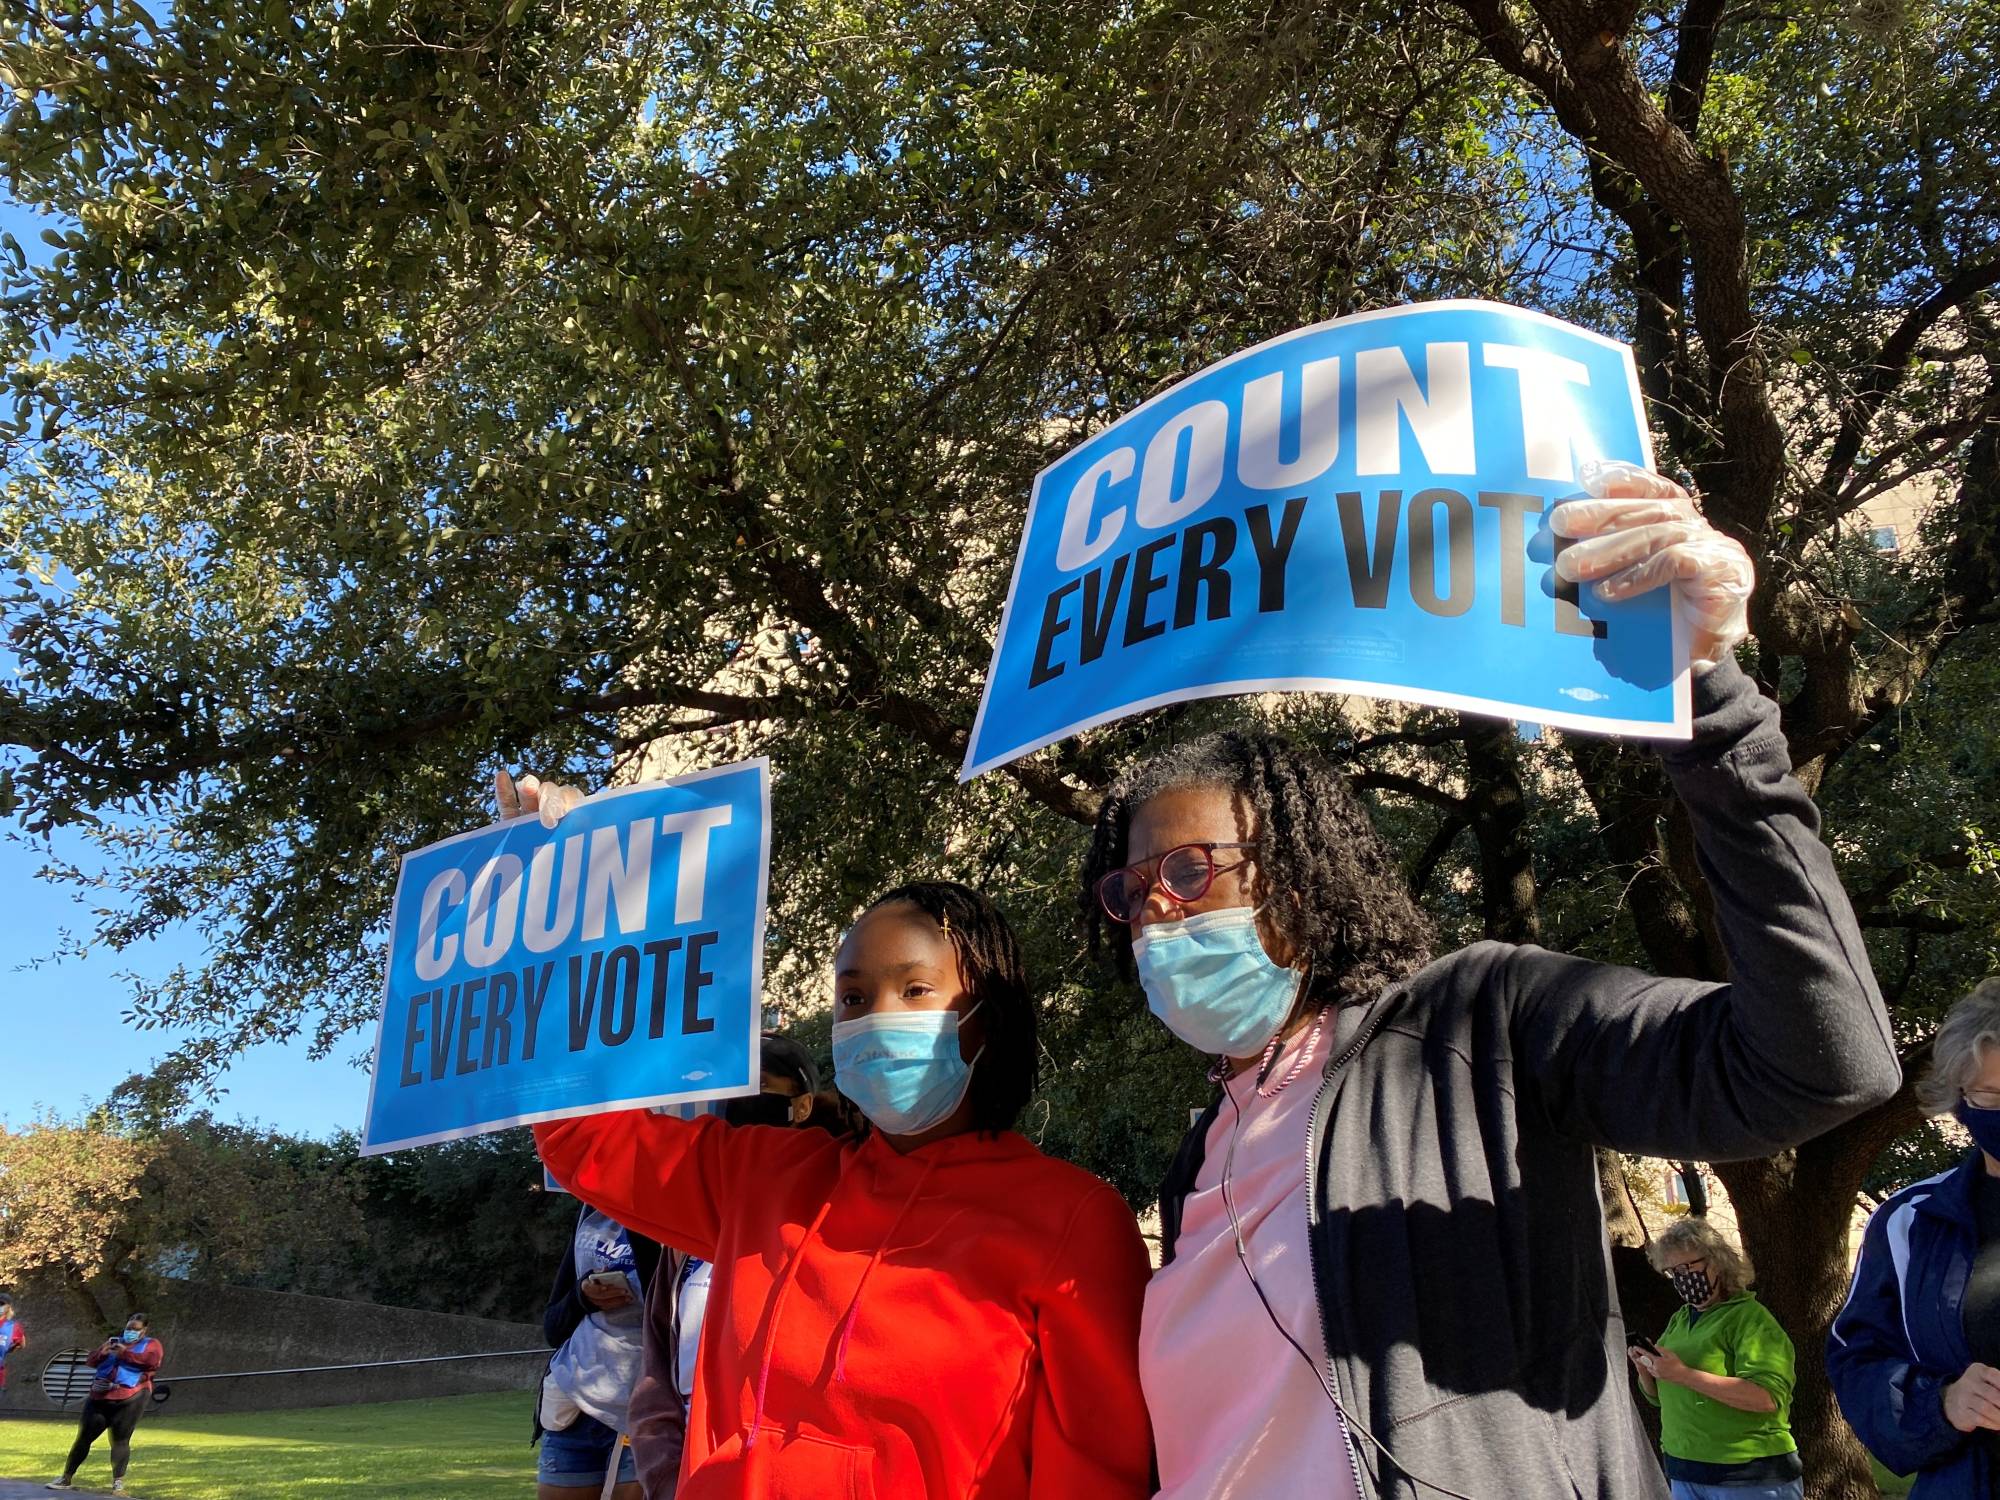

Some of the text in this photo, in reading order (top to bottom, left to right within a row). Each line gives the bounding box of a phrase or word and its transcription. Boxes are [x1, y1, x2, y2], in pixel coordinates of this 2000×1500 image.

[1055, 341, 1590, 573] COUNT
[1027, 496, 1308, 689] EVERY
[415, 804, 733, 981] COUNT
[399, 930, 719, 1088] EVERY VOTE
